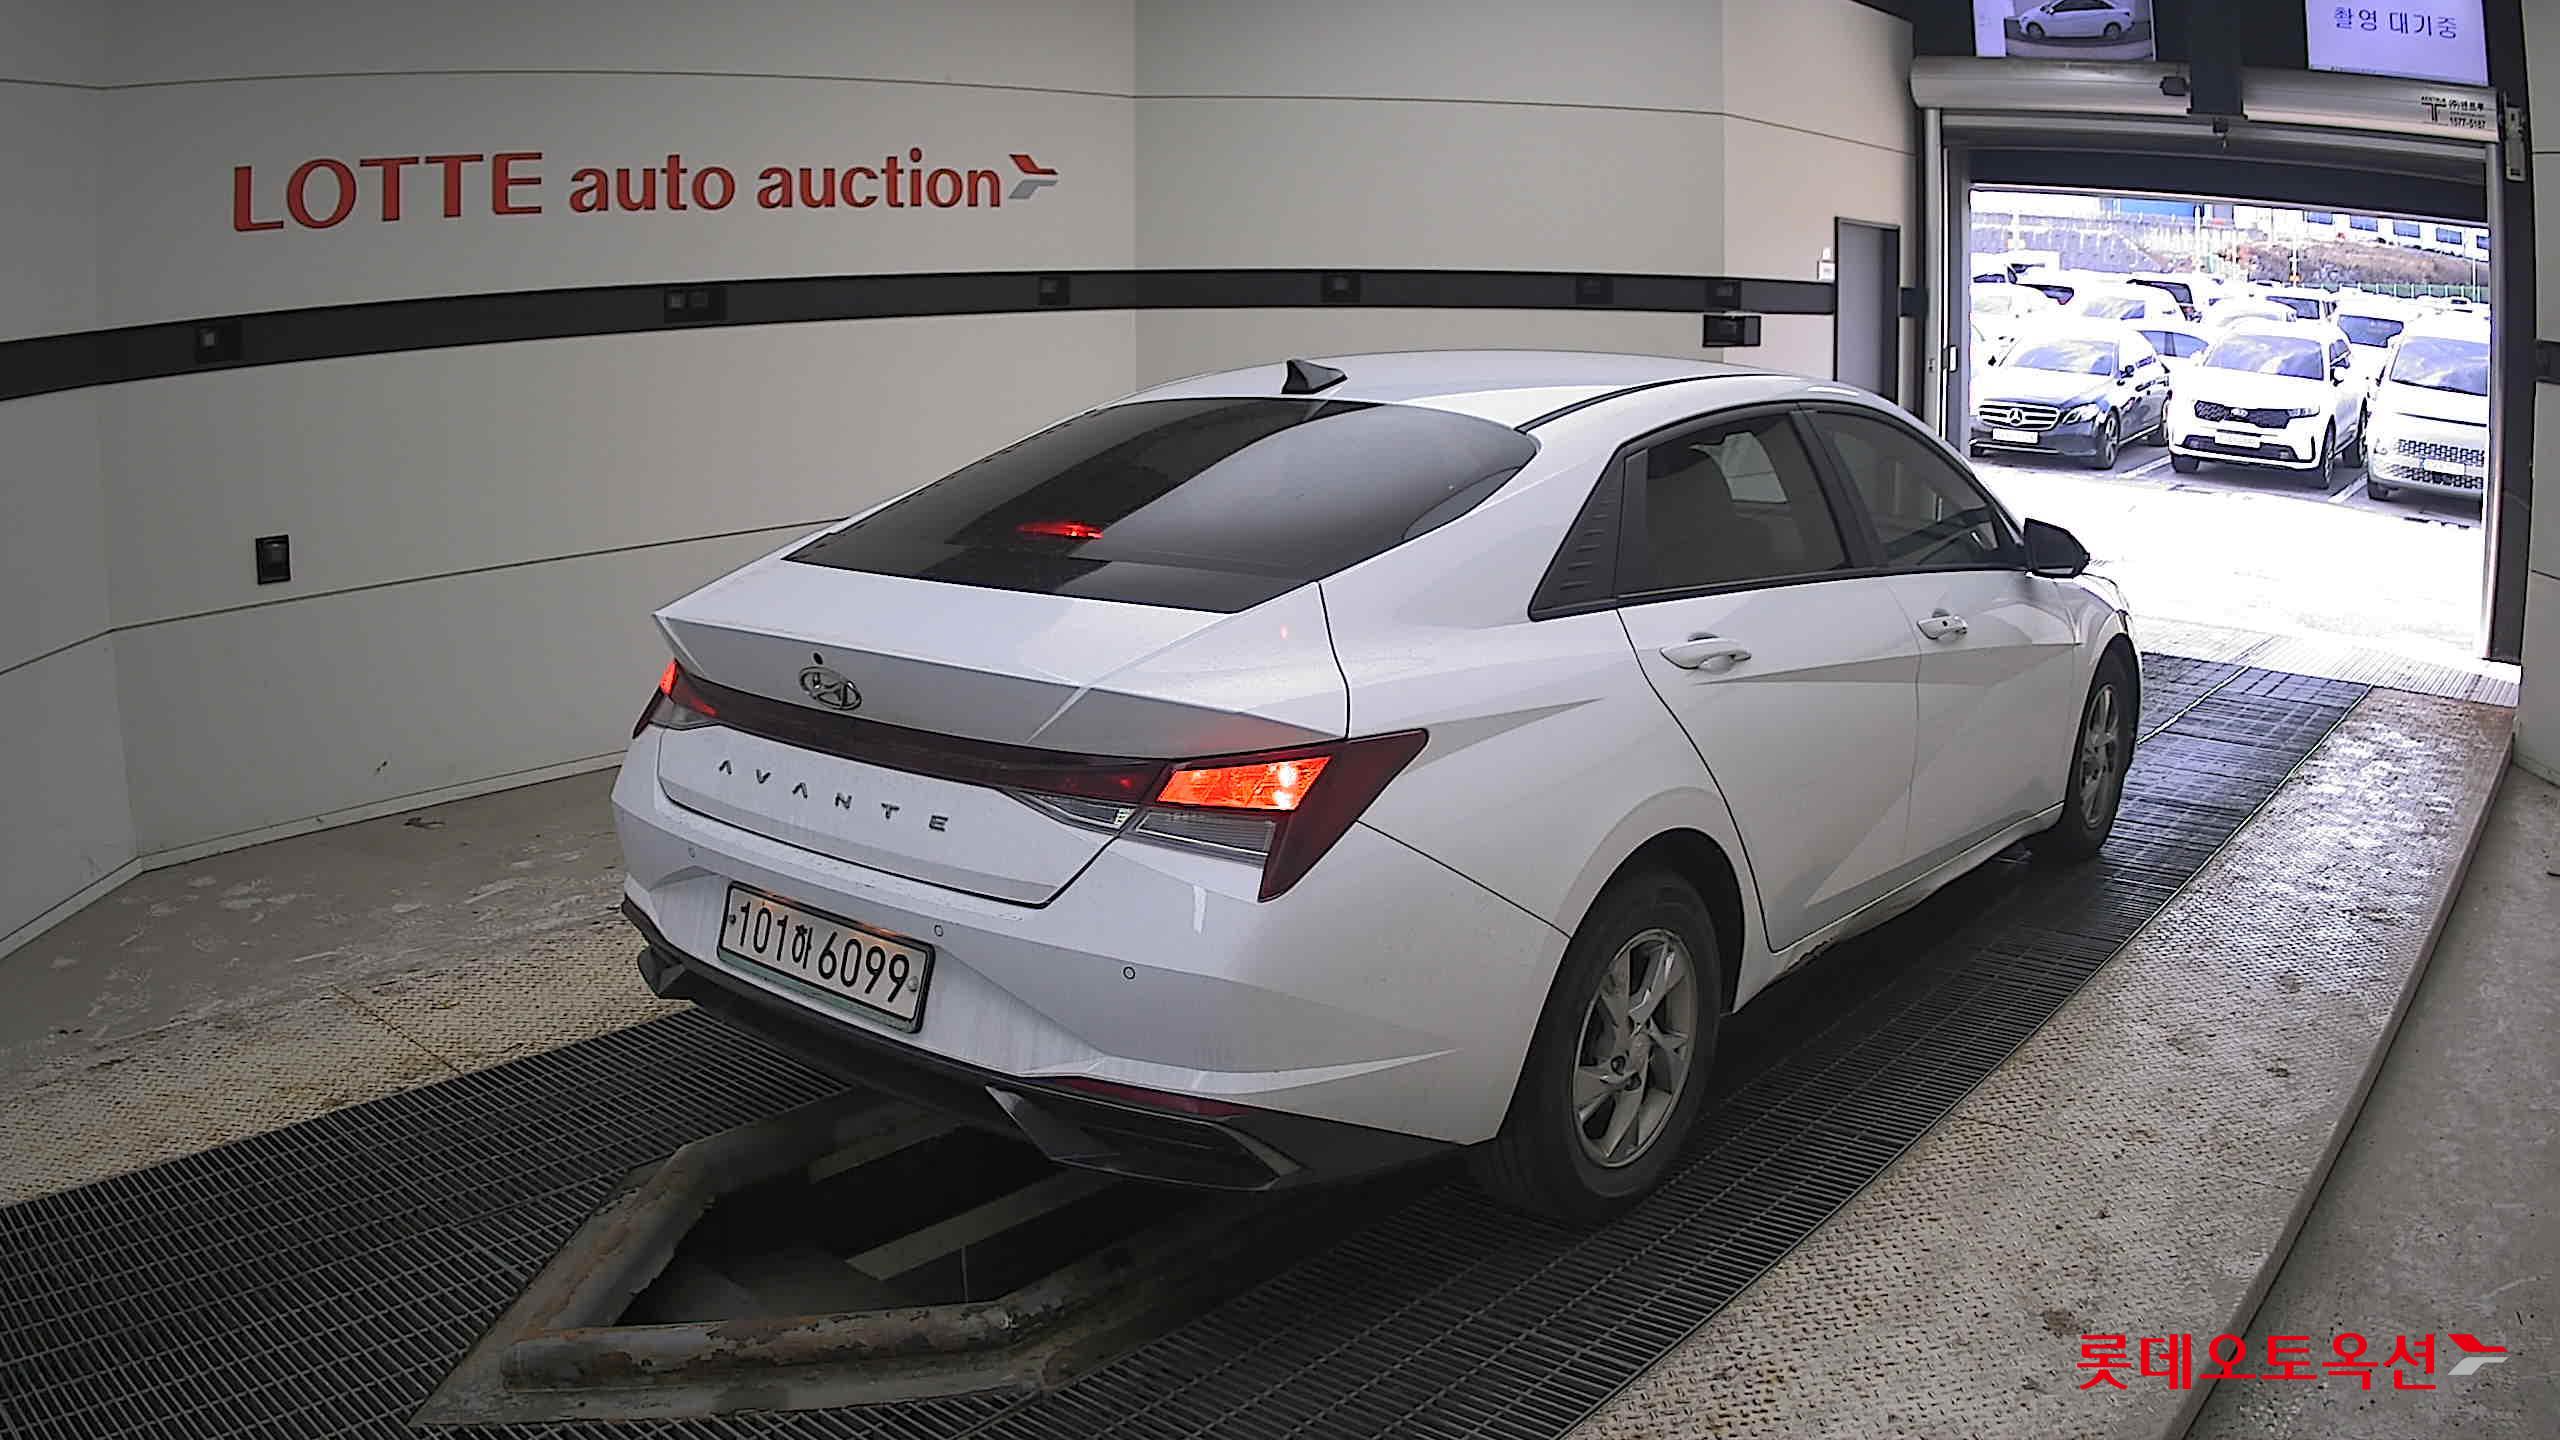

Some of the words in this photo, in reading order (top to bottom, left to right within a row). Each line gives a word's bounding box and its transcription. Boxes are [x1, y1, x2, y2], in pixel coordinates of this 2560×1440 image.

[2334, 6, 2378, 32] 촬영
[2389, 11, 2457, 40] 대기중
[233, 152, 543, 232] LOTTE
[568, 153, 737, 213] auto
[756, 146, 1003, 211] auction
[718, 759, 949, 833] AVANTE
